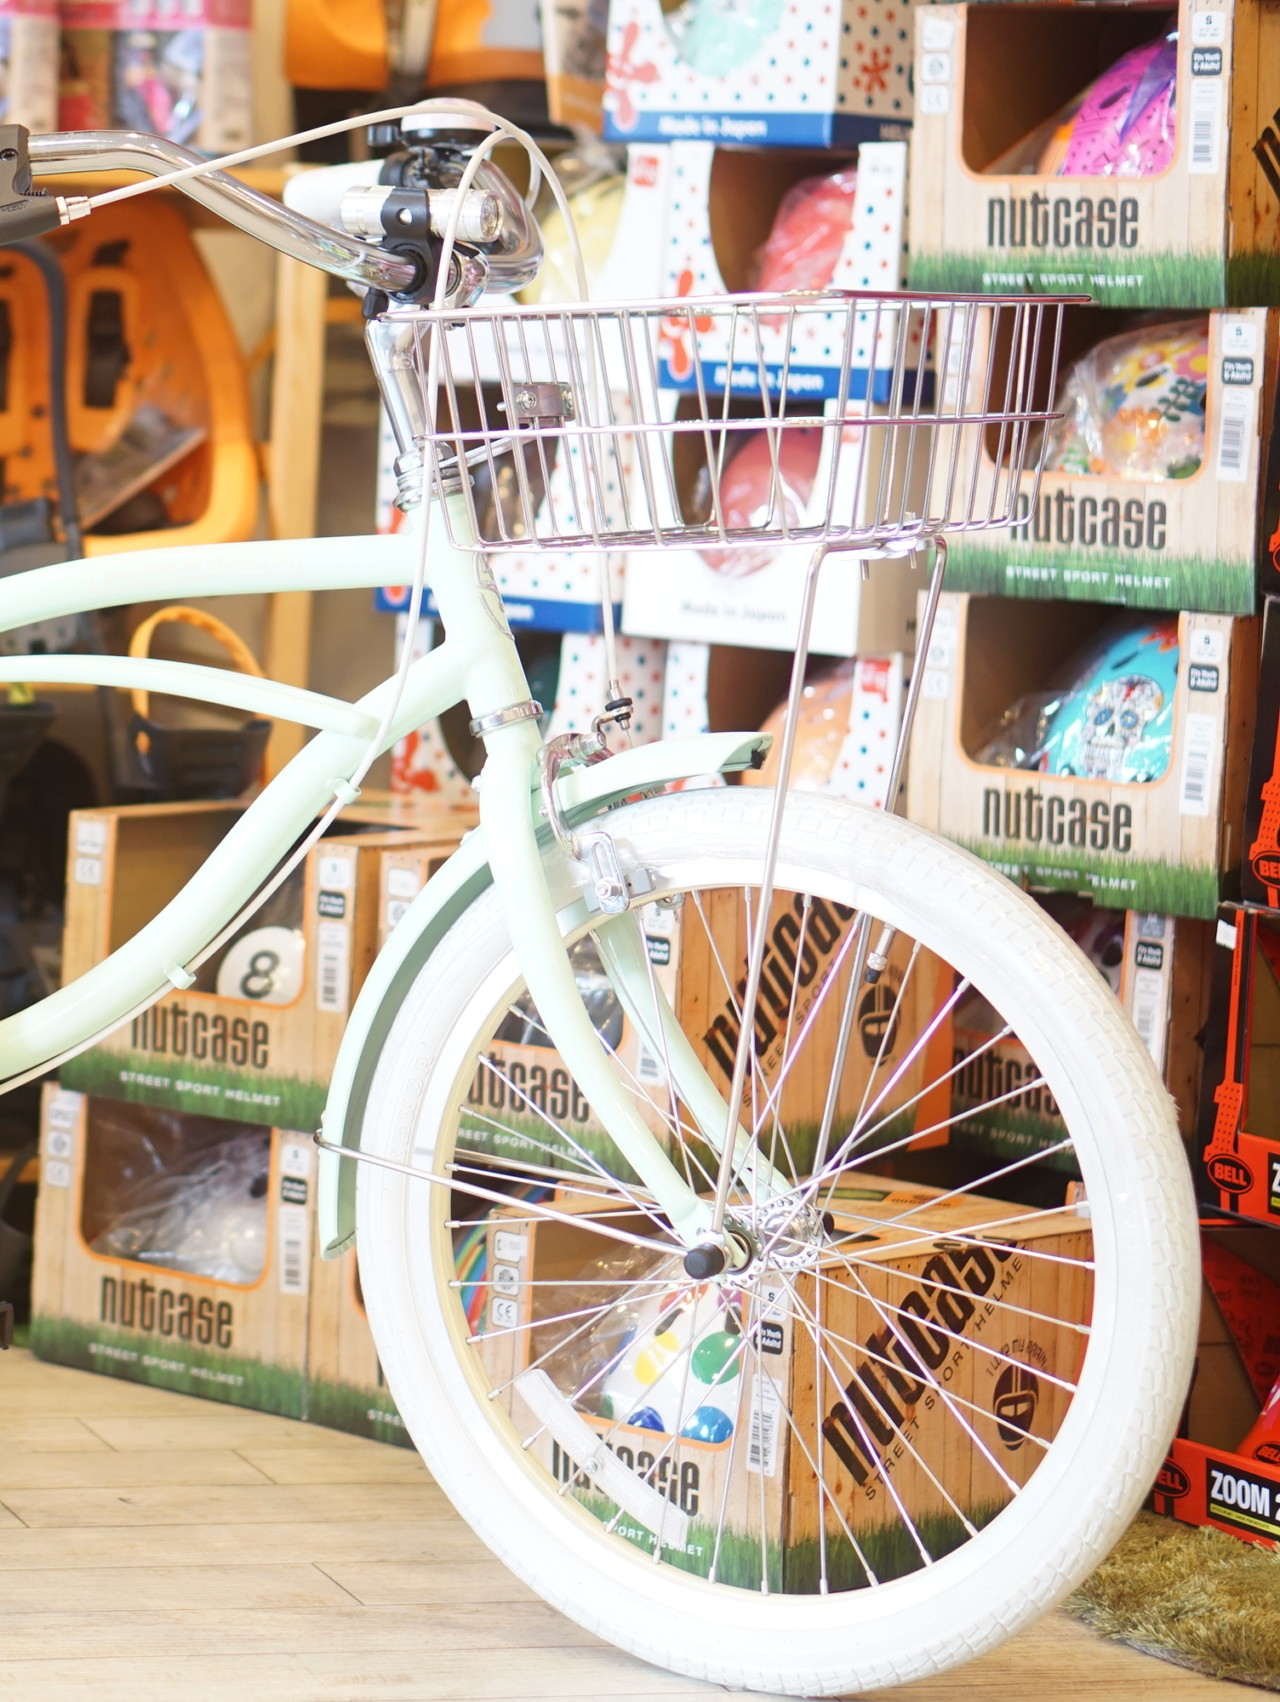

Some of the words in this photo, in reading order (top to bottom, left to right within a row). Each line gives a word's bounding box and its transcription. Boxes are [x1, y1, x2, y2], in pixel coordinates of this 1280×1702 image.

[988, 191, 1139, 248] nutcase
[982, 272, 1035, 286] STREET
[1039, 273, 1085, 286] SPORT
[1090, 274, 1145, 288] HELMET
[1011, 488, 1167, 550] nutcase
[1006, 564, 1057, 582] STREET
[1063, 568, 1110, 585] SPORT
[1114, 573, 1171, 590] HELMET
[983, 787, 1132, 853] nutcase
[1035, 865, 1080, 880] SPORT
[240, 950, 280, 1000] 8
[132, 1002, 269, 1069] nutcase
[120, 1071, 170, 1088] STREET
[175, 1080, 220, 1096] SPORT
[225, 1088, 281, 1106] HELMET
[468, 1051, 590, 1123] utcase
[1214, 1162, 1247, 1186] BELL
[101, 1275, 233, 1349] nutcase
[89, 1341, 138, 1362] STREET
[142, 1354, 186, 1372] SPORT
[190, 1366, 244, 1387] HELMET
[1158, 1469, 1184, 1490] ELL
[1210, 1469, 1270, 1518] ZOOM
